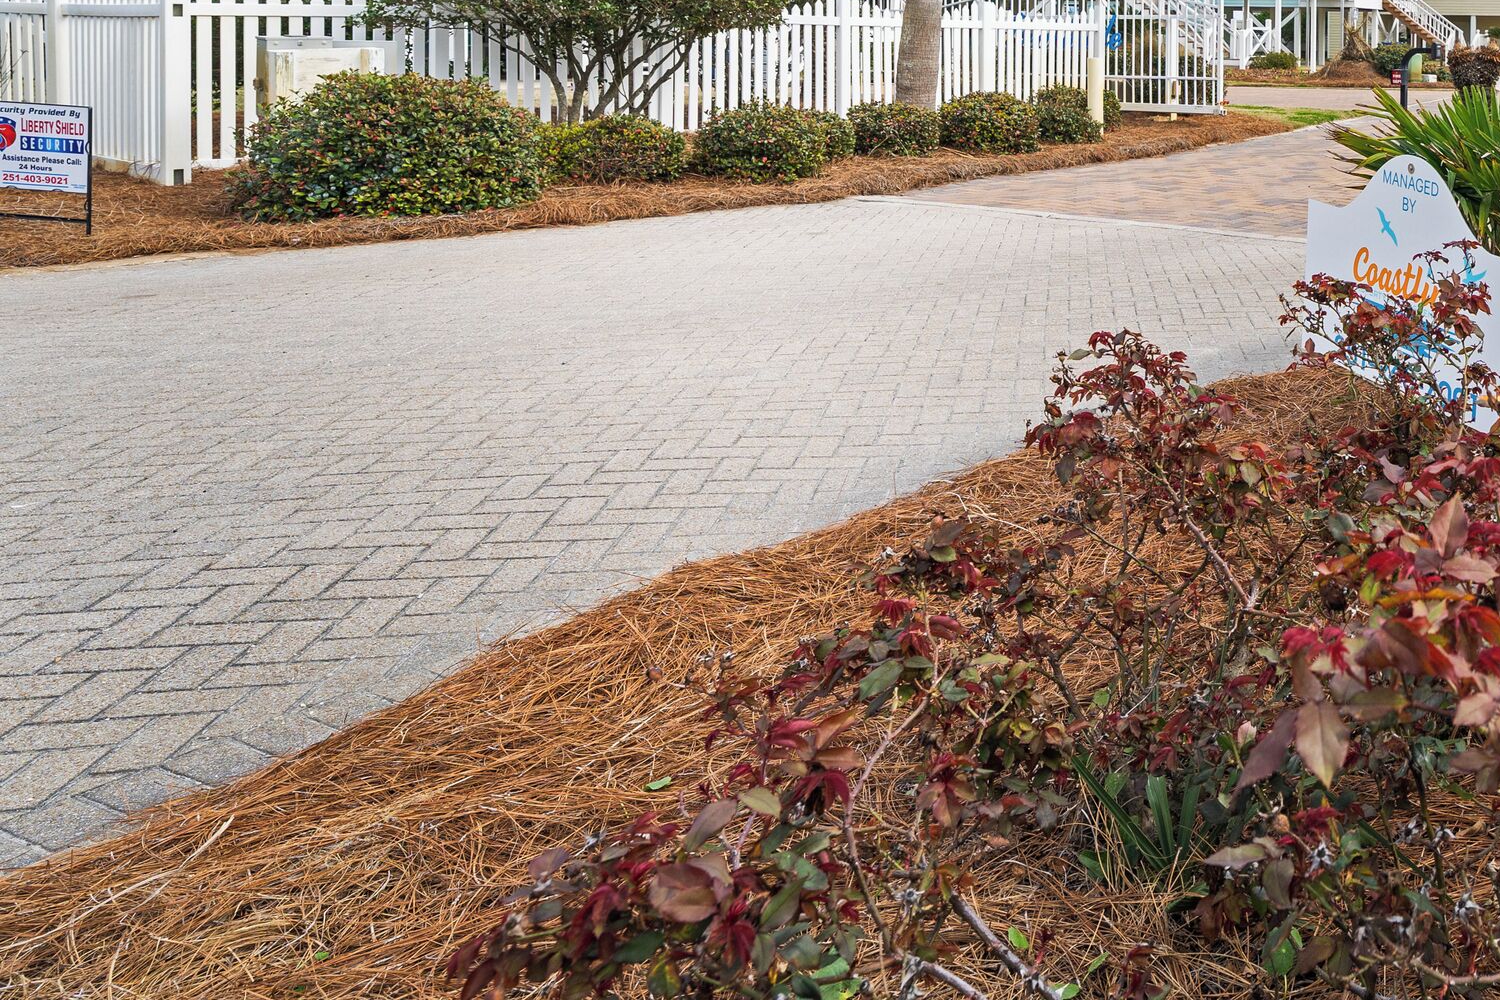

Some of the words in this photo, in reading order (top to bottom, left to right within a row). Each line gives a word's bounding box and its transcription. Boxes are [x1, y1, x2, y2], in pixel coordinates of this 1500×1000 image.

[0, 107, 25, 116] curity
[29, 108, 66, 116] Provided
[69, 110, 81, 118] By
[21, 118, 54, 134] LIBERTY
[56, 120, 84, 136] SHIELD
[22, 137, 82, 152] SECURITY
[2, 154, 40, 163] Assistance
[42, 156, 65, 165] Please
[66, 158, 82, 166] Call:
[2, 174, 68, 184] 251-403-9021
[1382, 169, 1439, 197] MANAGED
[1401, 197, 1417, 213] BY
